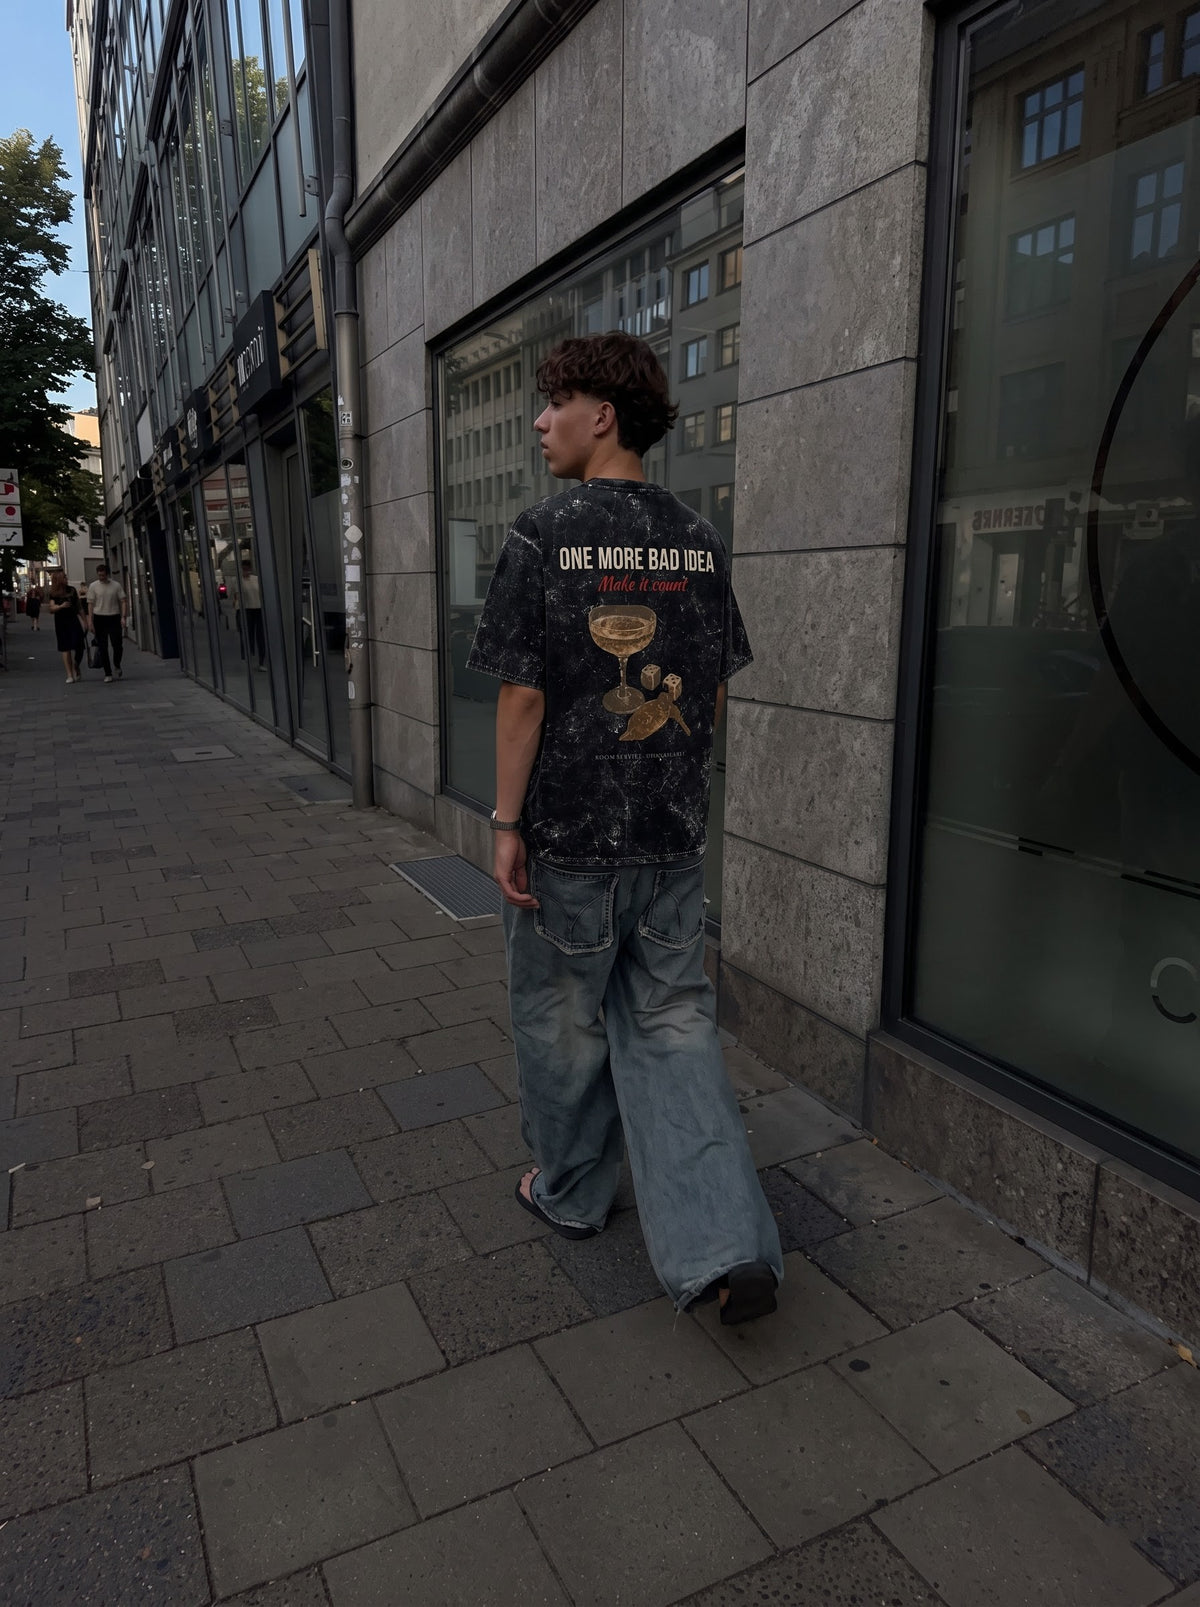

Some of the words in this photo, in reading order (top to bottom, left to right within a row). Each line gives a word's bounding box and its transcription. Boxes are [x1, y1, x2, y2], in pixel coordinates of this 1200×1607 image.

[559, 546, 593, 571] ONE
[598, 546, 645, 570] MORE
[648, 547, 680, 571] BAD
[684, 549, 715, 573] IDEA
[597, 574, 635, 593] Make
[638, 577, 650, 592] it
[652, 578, 689, 592] count
